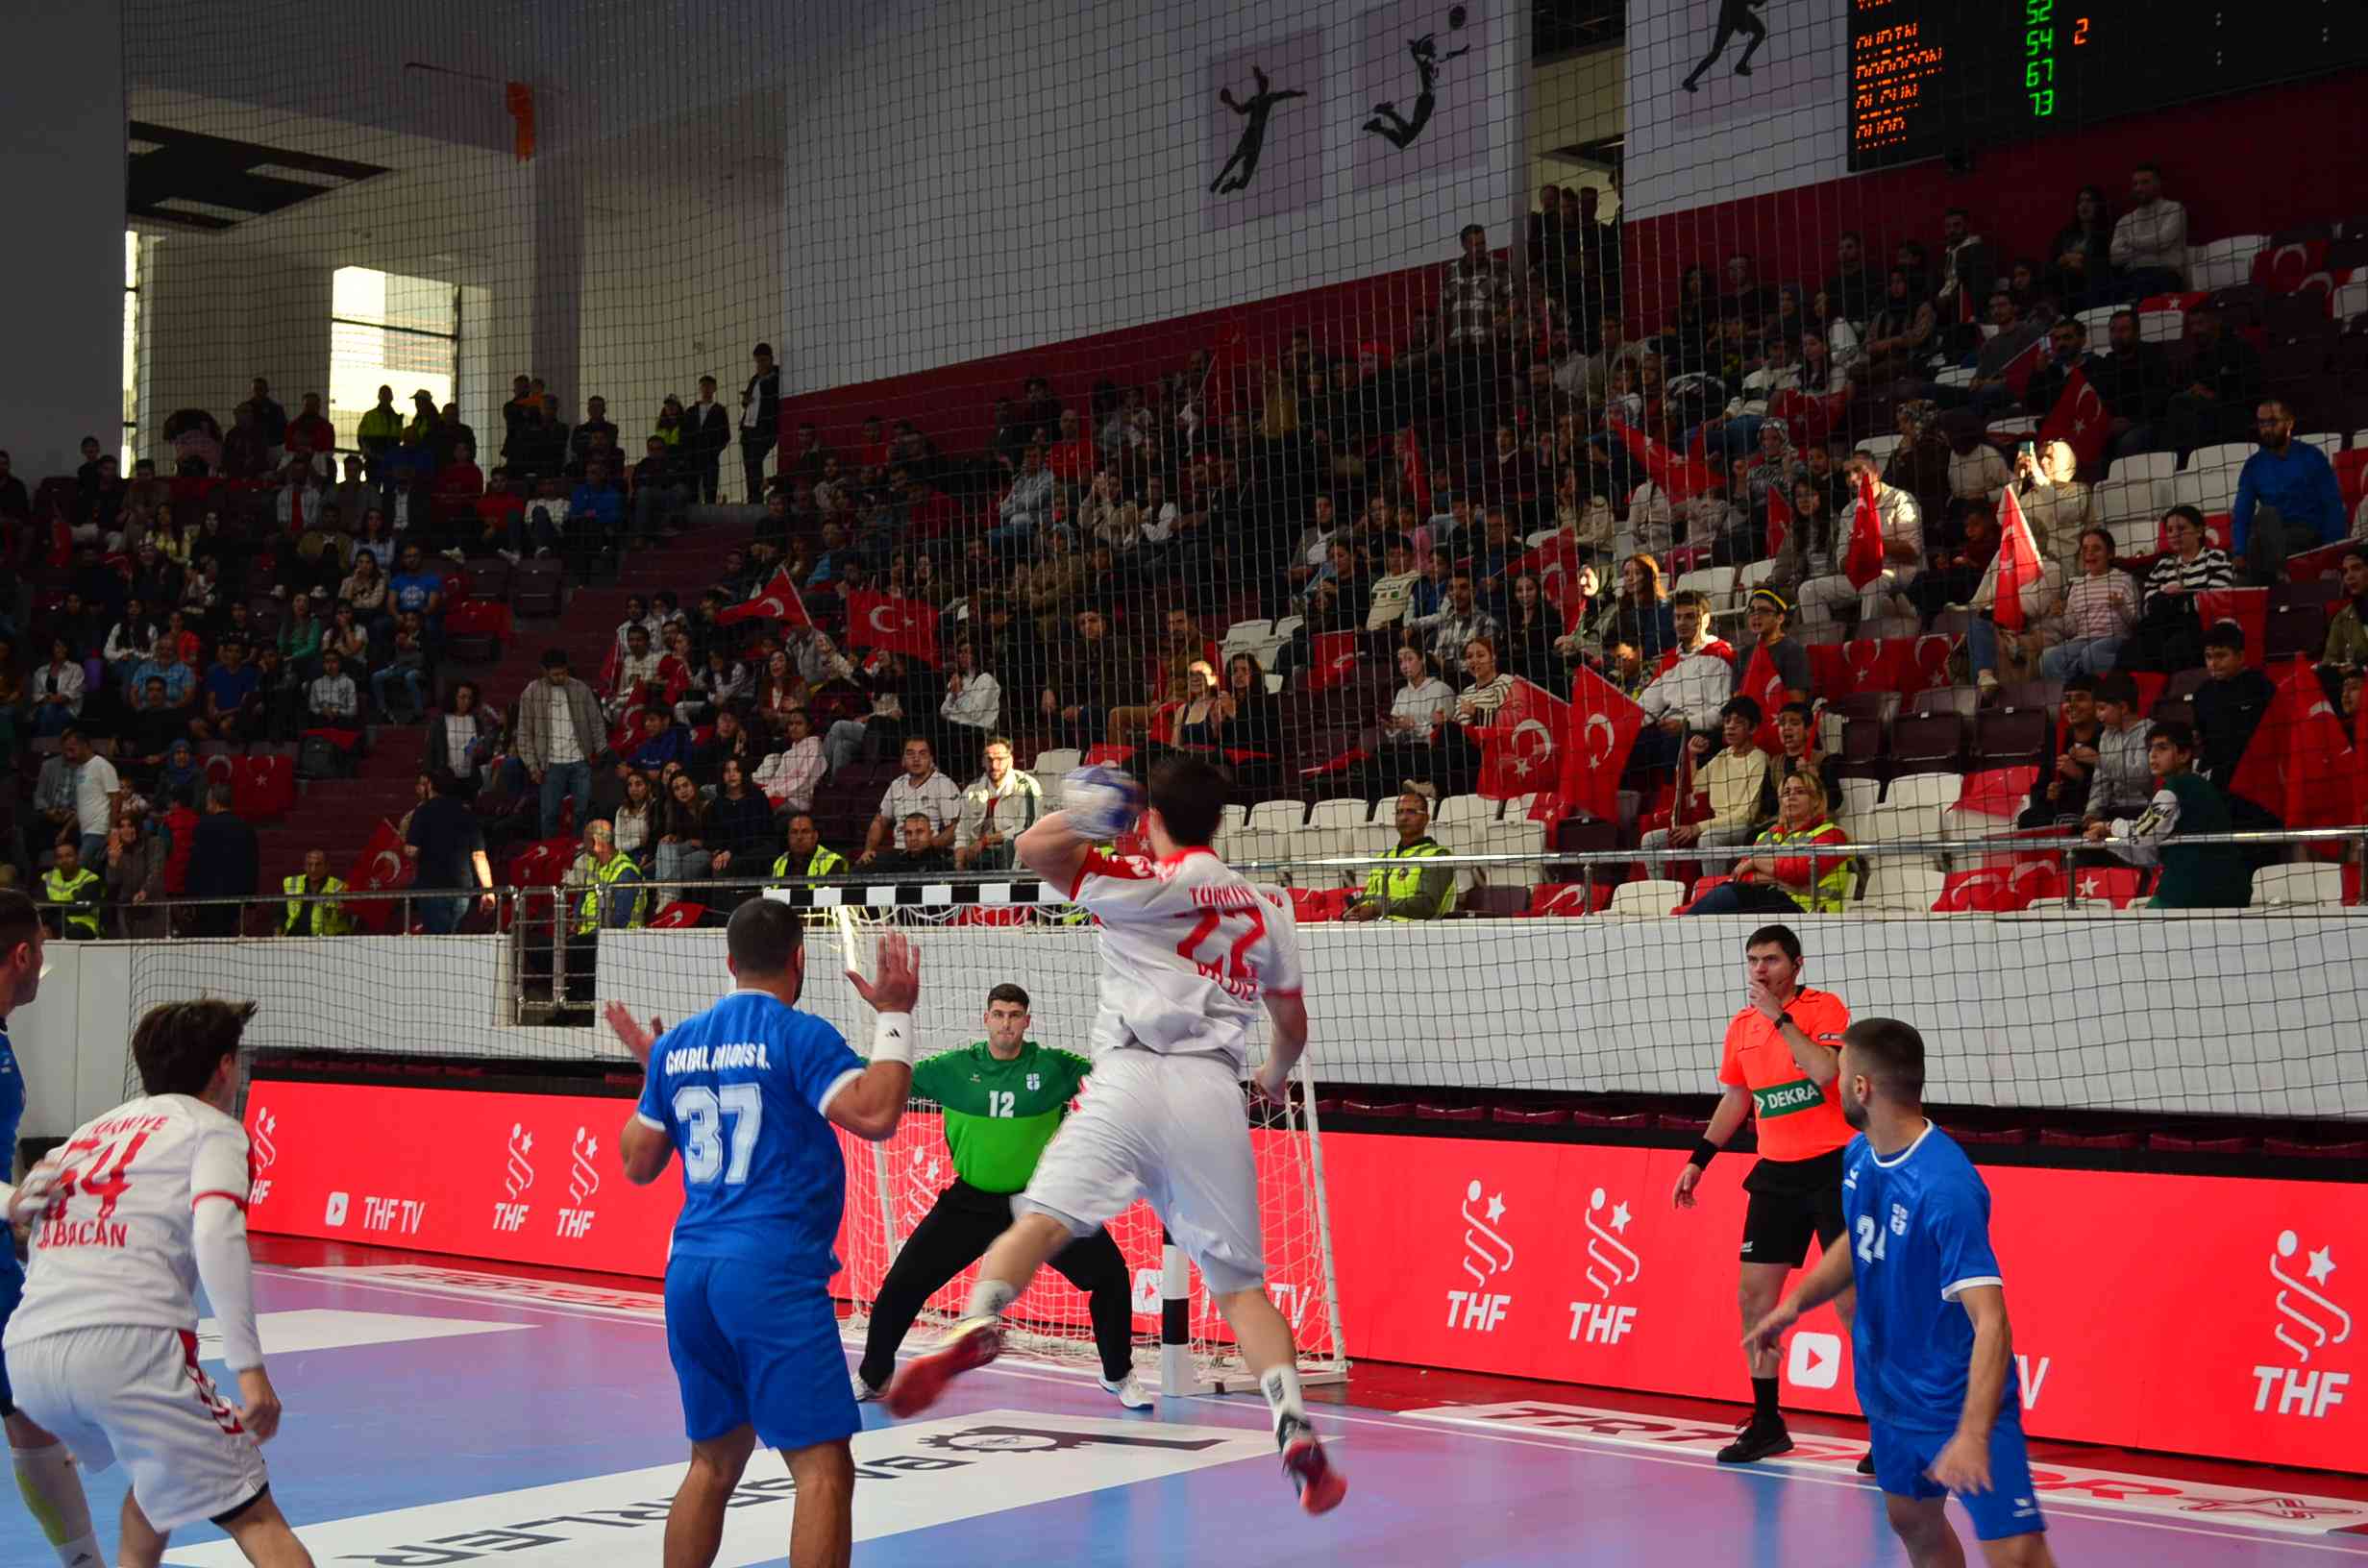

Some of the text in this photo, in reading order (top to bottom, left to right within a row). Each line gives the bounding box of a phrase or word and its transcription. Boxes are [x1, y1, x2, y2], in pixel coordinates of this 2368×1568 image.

[2026, 0, 2053, 25] 52
[2026, 28, 2053, 56] 54
[2074, 17, 2090, 46] 2
[2025, 58, 2054, 87] 67
[2029, 89, 2054, 116] 73
[989, 1090, 1015, 1118] 12
[1766, 1083, 1819, 1110] DEKRA
[672, 1082, 763, 1185] 37
[249, 1180, 272, 1205] HF
[362, 1196, 425, 1235] THF TV
[493, 1203, 530, 1232] THF
[556, 1209, 596, 1238] THF
[1447, 1290, 1512, 1332] THF
[1568, 1302, 1638, 1344] THF
[2014, 1354, 2050, 1410] V
[2253, 1365, 2351, 1417] THF
